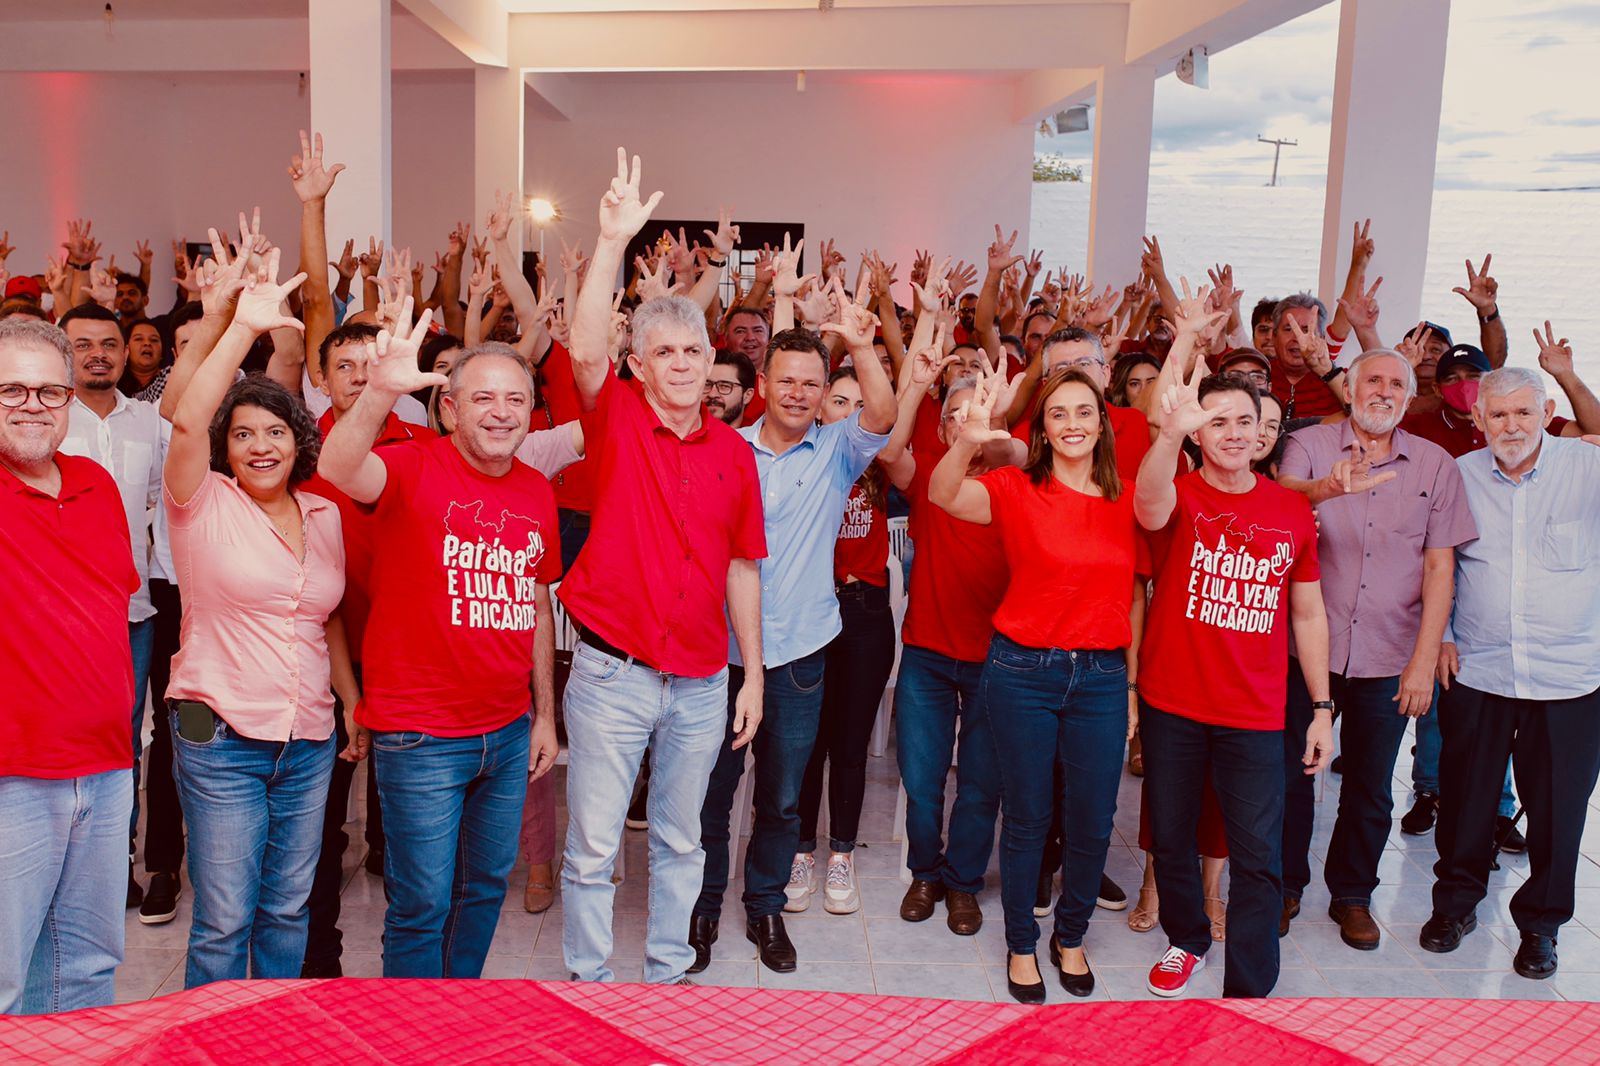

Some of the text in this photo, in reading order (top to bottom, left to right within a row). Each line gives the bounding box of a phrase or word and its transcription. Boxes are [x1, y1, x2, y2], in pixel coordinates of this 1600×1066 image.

[1216, 534, 1227, 553] A
[1190, 541, 1271, 583] Paraíba
[1201, 575, 1241, 609] LULA,
[451, 598, 463, 626] E
[1185, 595, 1275, 635] E RICARDO!
